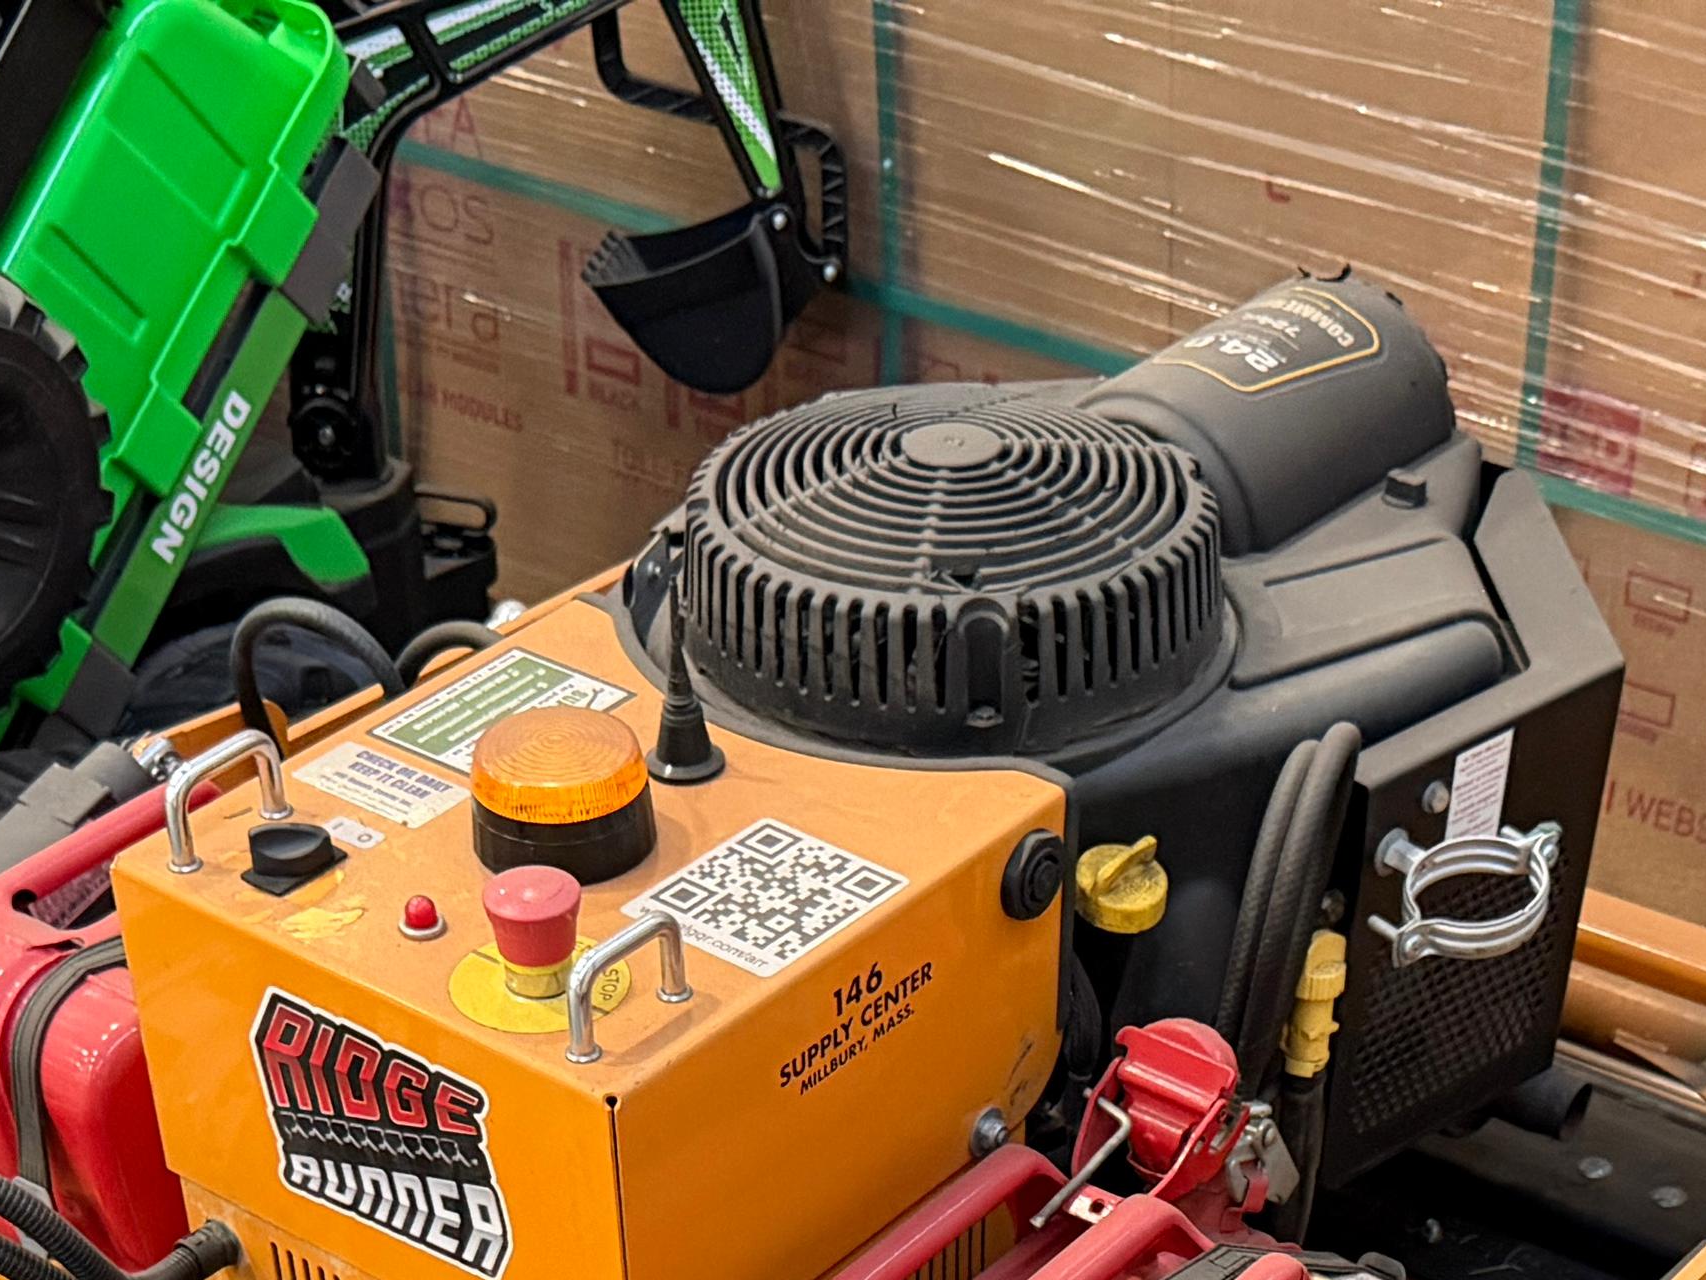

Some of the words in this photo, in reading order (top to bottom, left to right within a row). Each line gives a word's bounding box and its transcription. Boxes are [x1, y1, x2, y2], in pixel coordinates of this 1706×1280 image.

[151, 390, 252, 565] DESIGN
[348, 761, 381, 778] KEEP
[390, 779, 431, 799] CLEAN
[598, 968, 619, 1001] STOP
[780, 1017, 853, 1087] SUPPLY
[860, 962, 932, 1027] CENTER
[833, 961, 883, 1017] 146
[263, 1003, 479, 1135] RIDGE
[800, 1036, 868, 1095] MILLBURY,
[872, 1003, 915, 1041] MASS.
[290, 1153, 504, 1271] RUNNER
